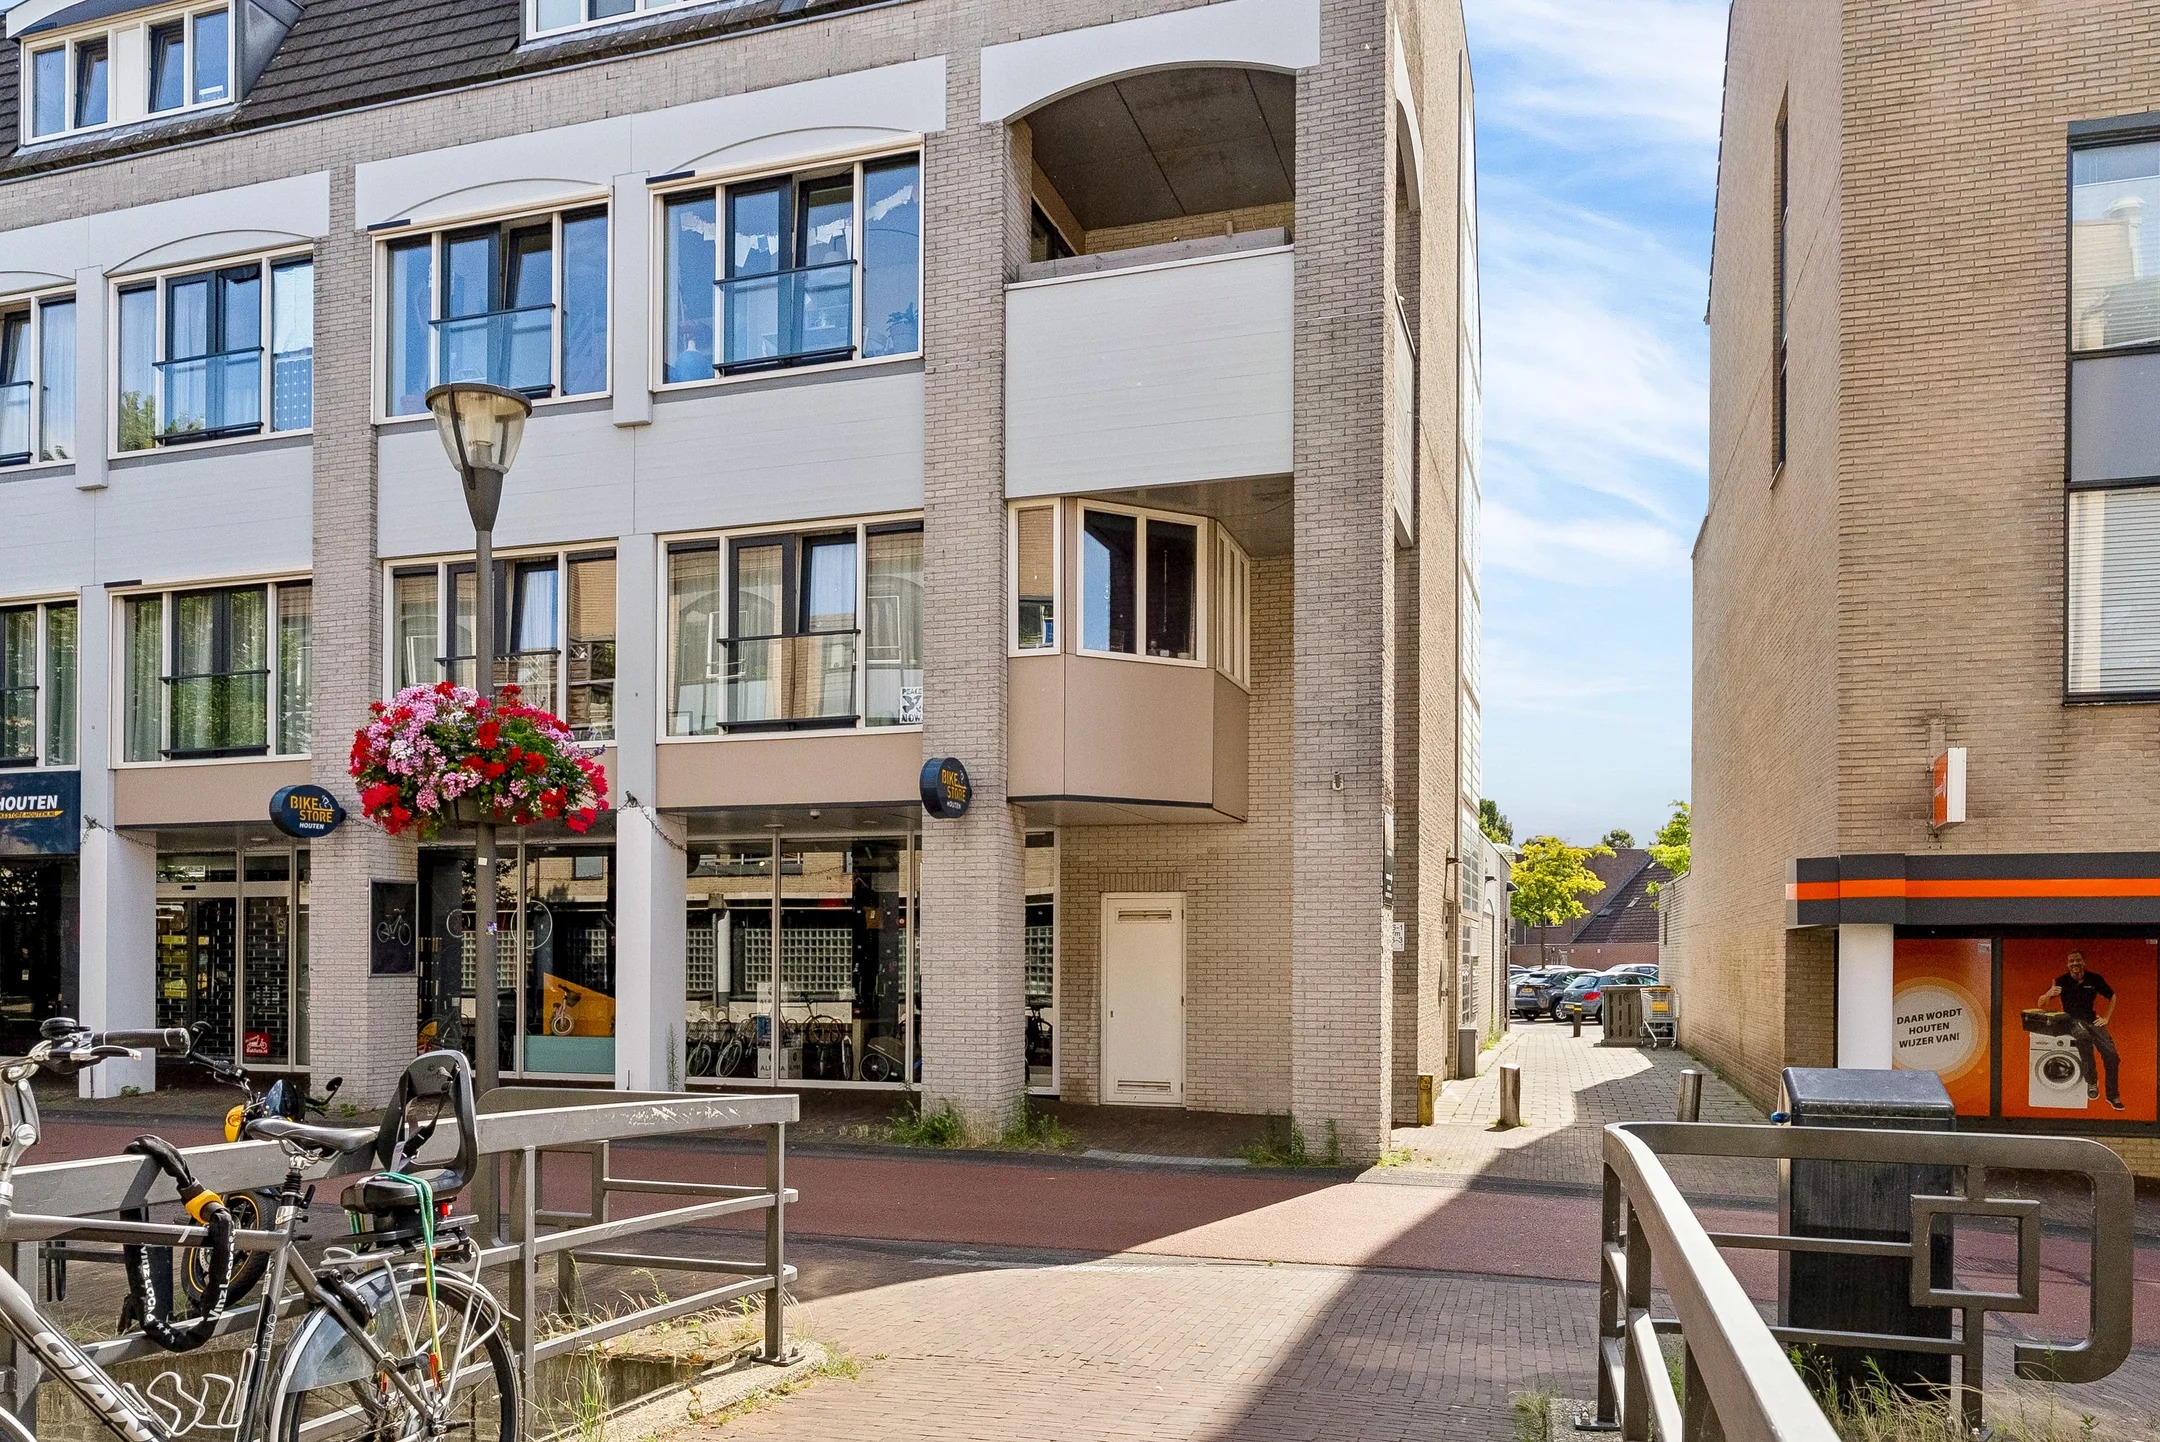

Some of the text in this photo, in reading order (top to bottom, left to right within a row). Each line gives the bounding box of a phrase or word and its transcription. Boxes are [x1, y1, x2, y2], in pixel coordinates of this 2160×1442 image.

[941, 769, 959, 786] BIKE
[947, 785, 966, 802] STORE
[290, 795, 319, 811] BIKE
[946, 800, 961, 809] HOUTEN
[300, 809, 333, 823] STORE
[299, 822, 325, 830] HOUTEN
[1896, 1008, 1963, 1025] DAAR WORDT
[1908, 1022, 1950, 1035] HOUTEN
[1899, 1032, 1960, 1048] WIJZER VAN!
[33, 1332, 162, 1442] GIAN
